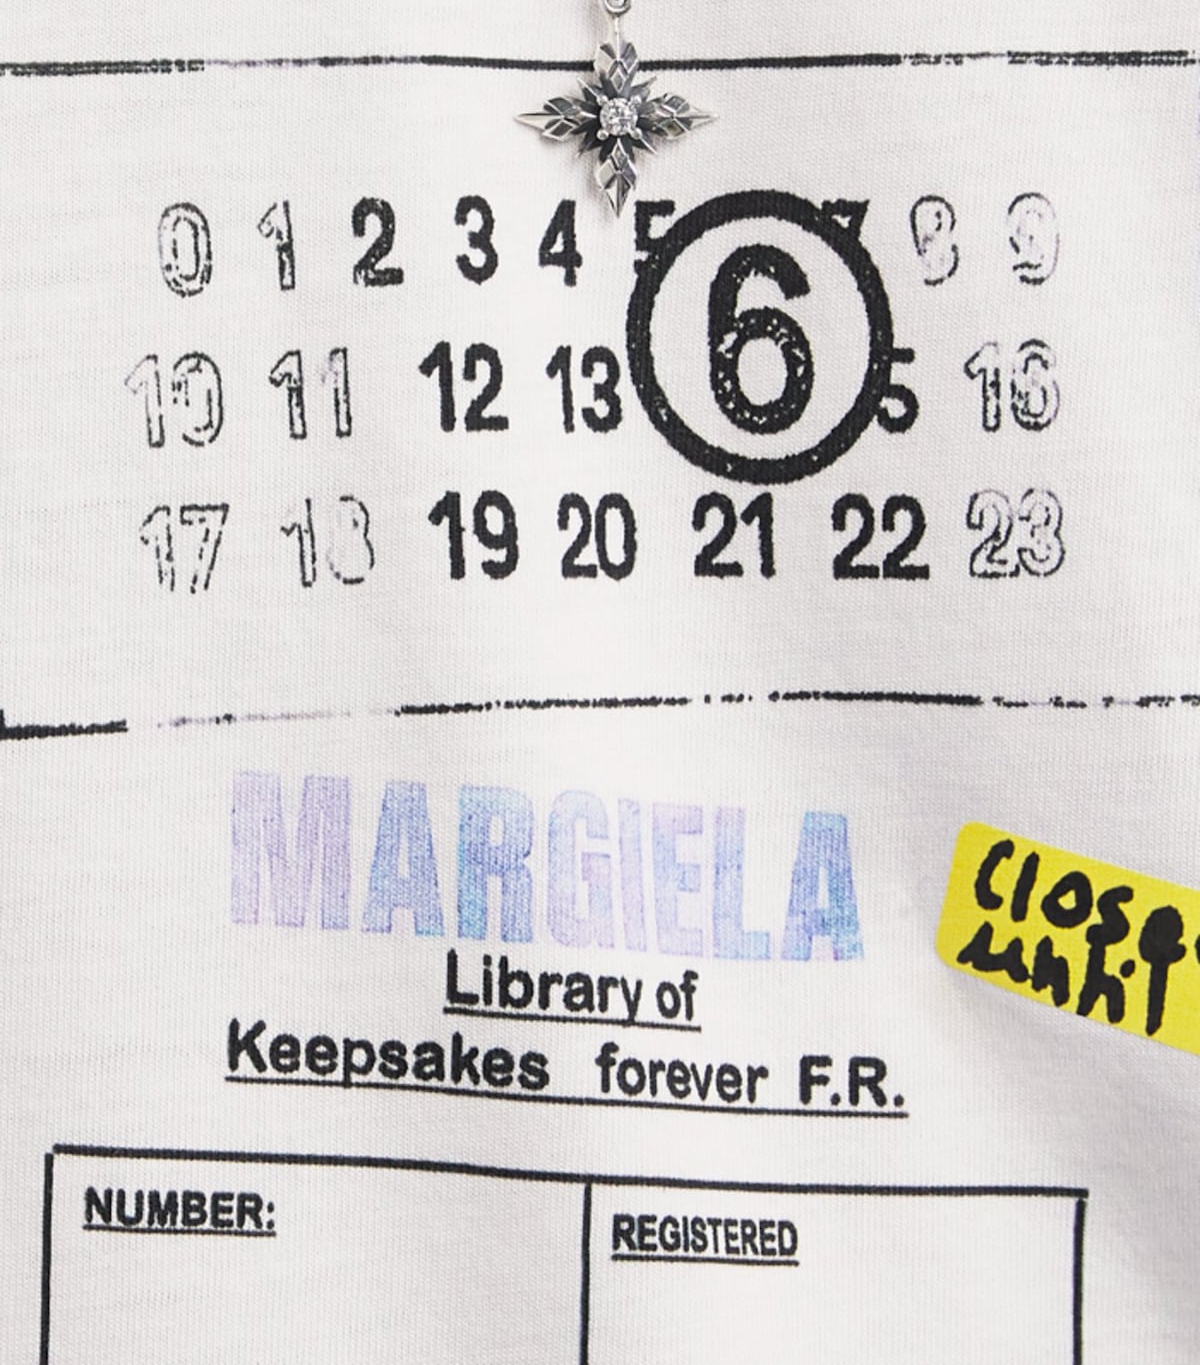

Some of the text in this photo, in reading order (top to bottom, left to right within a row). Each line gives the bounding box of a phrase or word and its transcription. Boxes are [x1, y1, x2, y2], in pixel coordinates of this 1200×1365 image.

[158, 202, 213, 299] 0
[256, 199, 296, 292] 1
[351, 196, 404, 288] 2
[454, 195, 499, 286] 3
[538, 198, 583, 288] 4
[708, 242, 814, 435] 6
[124, 351, 224, 449] 10
[268, 346, 352, 440] 11
[418, 340, 509, 433] 12
[545, 345, 623, 434] 13
[140, 502, 230, 594] 17
[428, 489, 520, 581] 19
[557, 492, 638, 582] 20
[691, 491, 776, 580] 21
[831, 492, 930, 582] 22
[965, 488, 1066, 580] 23
[230, 769, 865, 962] MARGIELA
[445, 949, 698, 1026] Library of
[226, 1018, 905, 1108] Keepsakes forever F.R.
[84, 1186, 277, 1231] NUMBER:
[611, 1213, 799, 1257] REGISTERED
